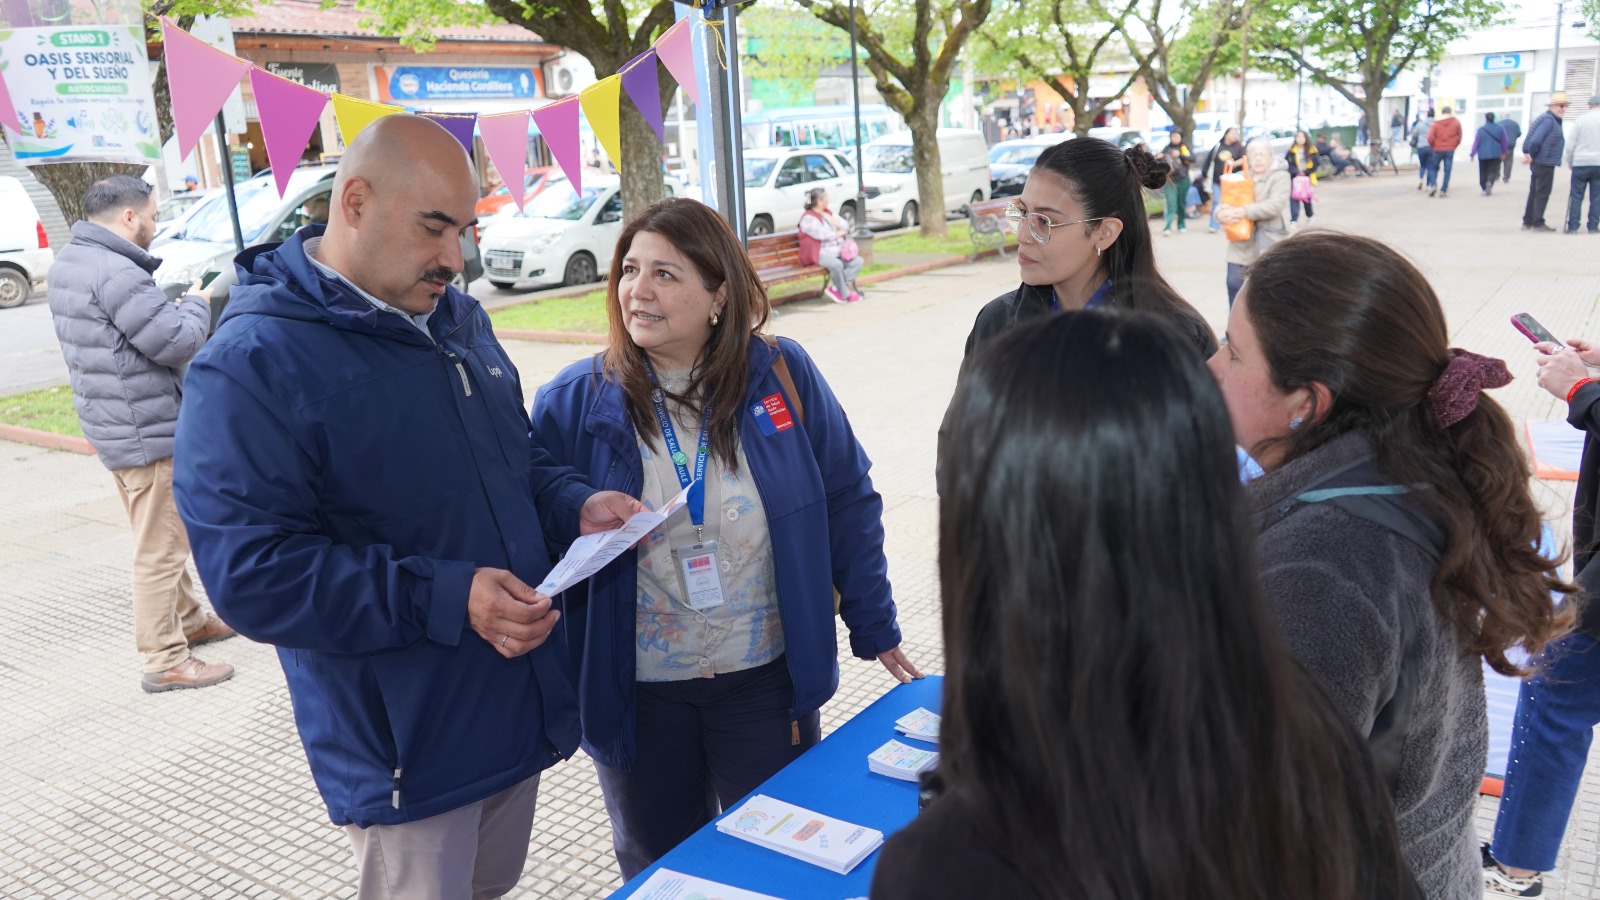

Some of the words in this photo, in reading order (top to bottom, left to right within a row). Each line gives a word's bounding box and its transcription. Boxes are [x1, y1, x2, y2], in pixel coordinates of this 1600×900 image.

[59, 33, 96, 45] STAND
[98, 33, 104, 44] 1
[24, 52, 72, 66] OASIS
[76, 52, 135, 65] SENSORIAL
[47, 68, 57, 80] Y
[64, 67, 90, 79] DEL
[93, 64, 129, 79] SUEÑO
[267, 62, 304, 77] Fuente
[68, 85, 123, 93] AUTOCUIDADO
[426, 80, 470, 92] Hacienda
[471, 80, 514, 92] Cordillera
[655, 402, 669, 429] ERVICIO
[664, 429, 673, 438] DE
[667, 437, 679, 457] SALU
[677, 463, 689, 483] AULE
